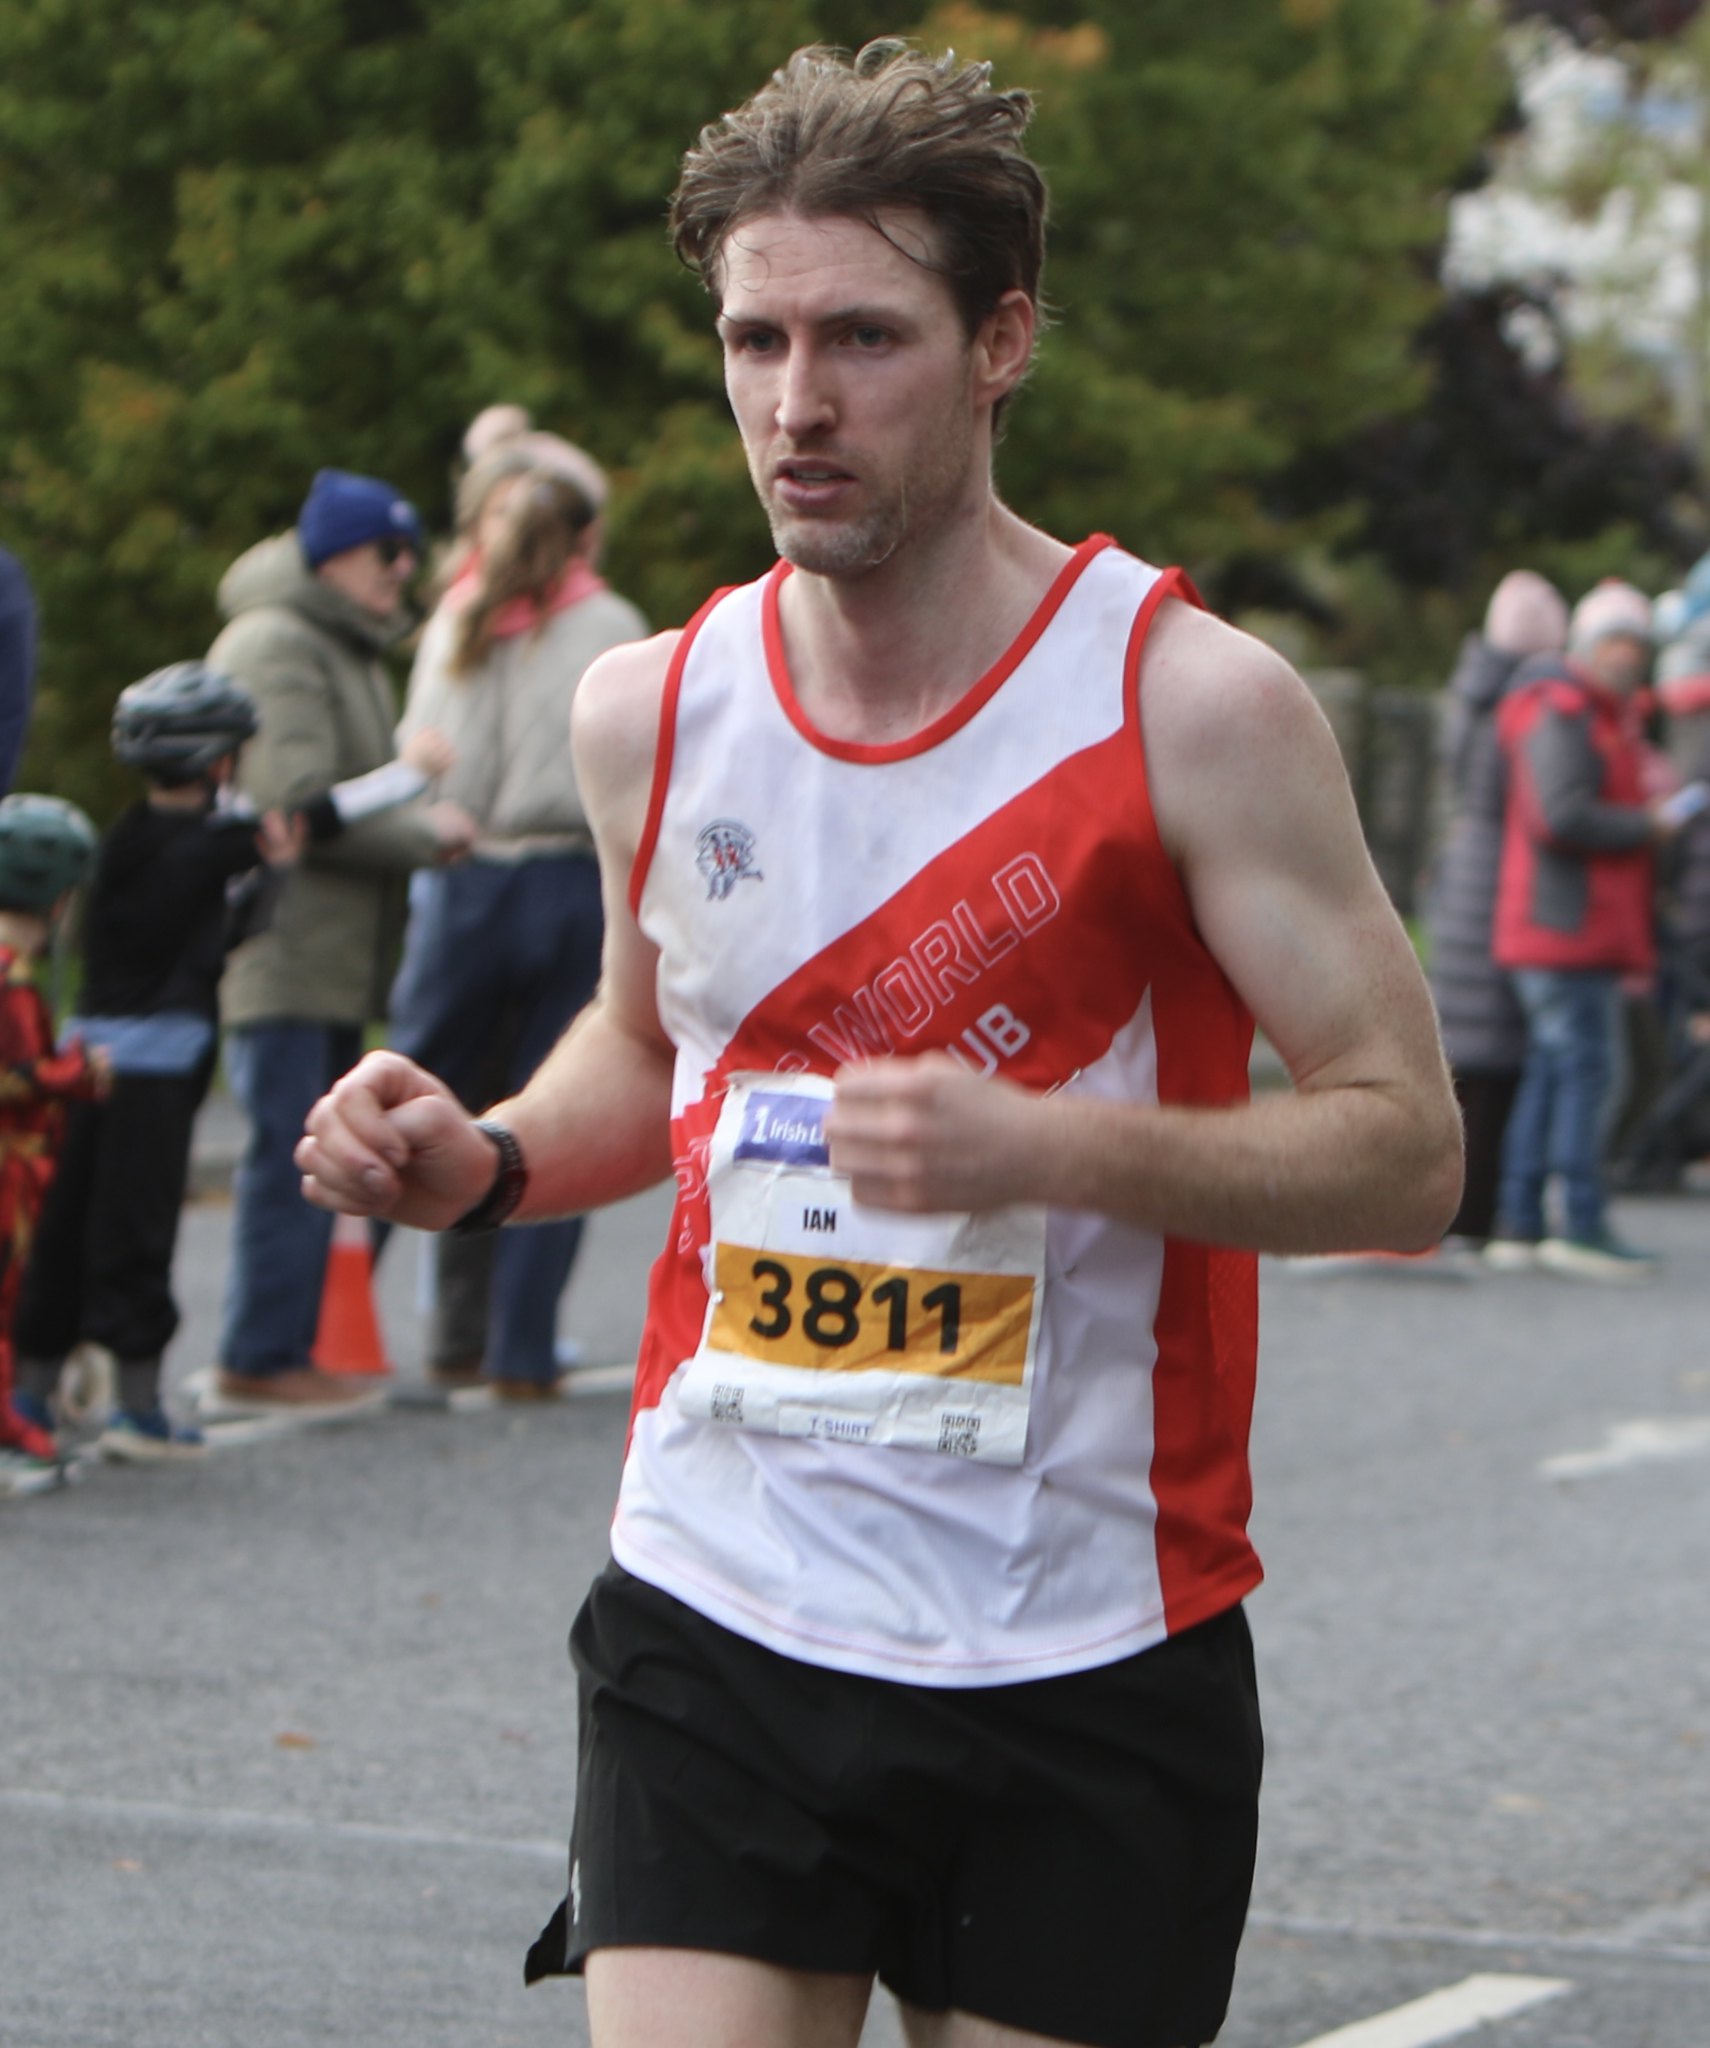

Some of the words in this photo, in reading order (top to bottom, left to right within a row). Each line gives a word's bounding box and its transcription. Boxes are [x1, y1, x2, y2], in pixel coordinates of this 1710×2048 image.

[946, 1002, 1031, 1081] UB
[769, 1118, 808, 1145] Irish
[803, 1207, 837, 1232] IAN
[749, 1259, 961, 1356] 3811
